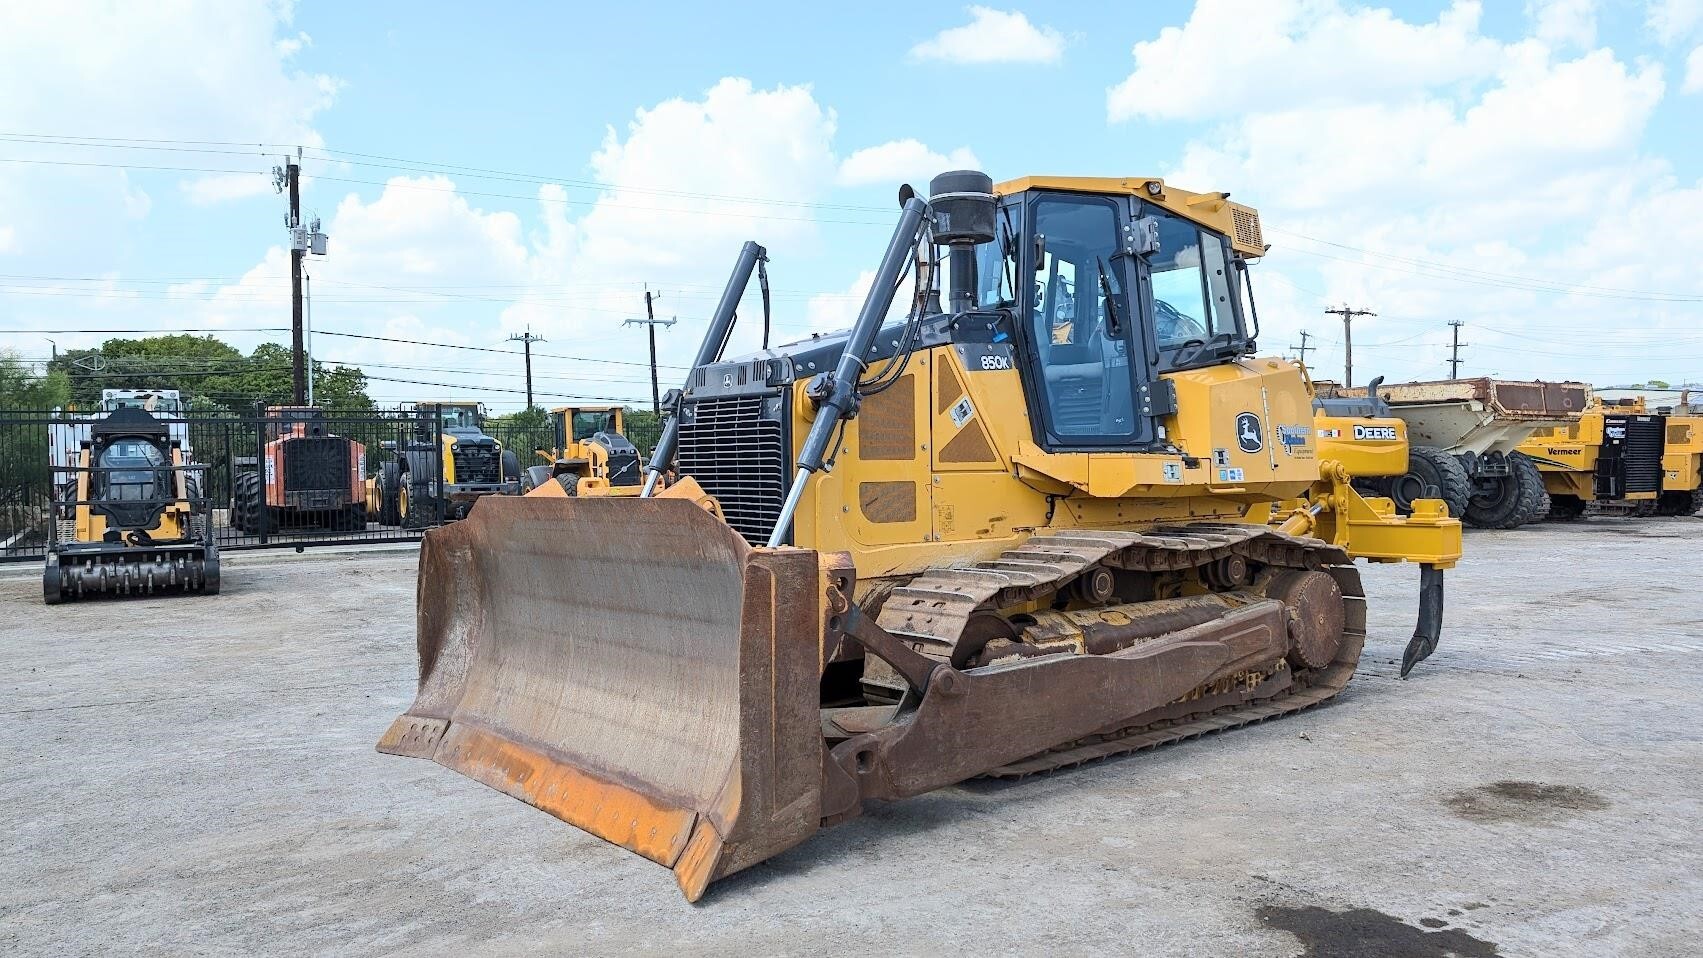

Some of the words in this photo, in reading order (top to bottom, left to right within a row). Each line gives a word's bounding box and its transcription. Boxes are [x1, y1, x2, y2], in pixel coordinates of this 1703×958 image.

[981, 355, 1009, 370] 850K
[1353, 425, 1396, 440] DEERE
[1547, 447, 1581, 455] Vermeer
